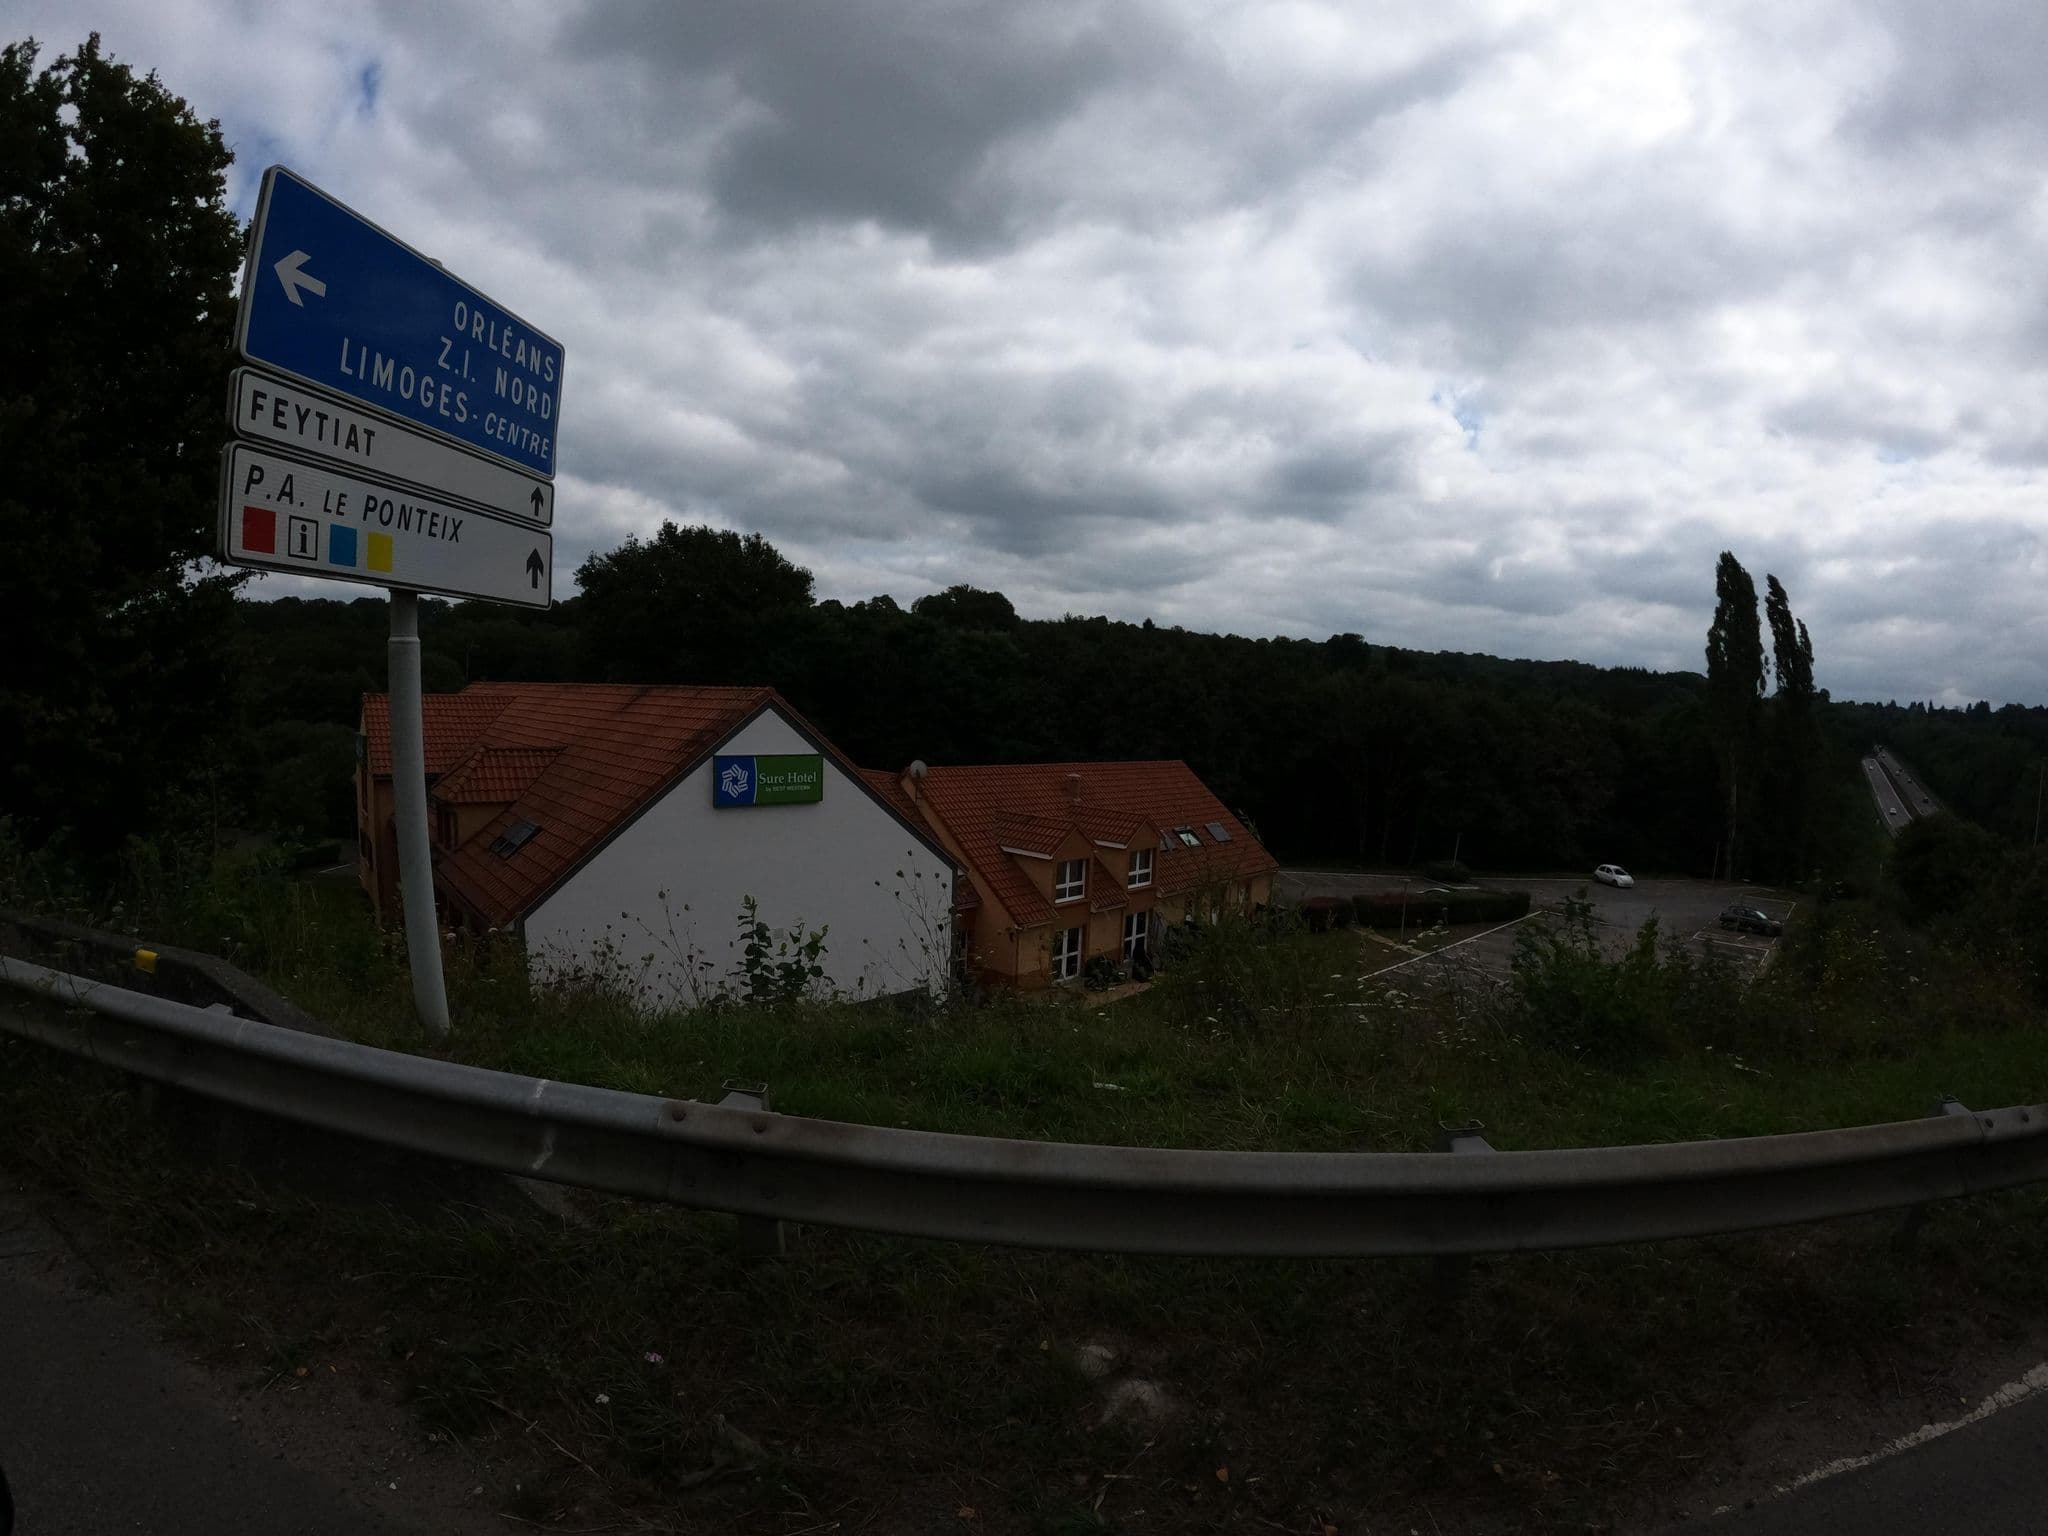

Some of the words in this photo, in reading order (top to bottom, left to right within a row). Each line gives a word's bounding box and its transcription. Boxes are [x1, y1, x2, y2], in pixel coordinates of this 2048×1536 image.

[438, 337, 476, 383] Z.I.
[495, 366, 552, 420] NORD
[454, 301, 555, 382] ORLÉANS
[250, 389, 376, 457] FEYTIAT
[244, 465, 304, 507] P.A.
[323, 489, 347, 516] LE
[363, 494, 465, 544] PONTEIX
[759, 772, 784, 784] Sure
[788, 771, 816, 783] Hotel
